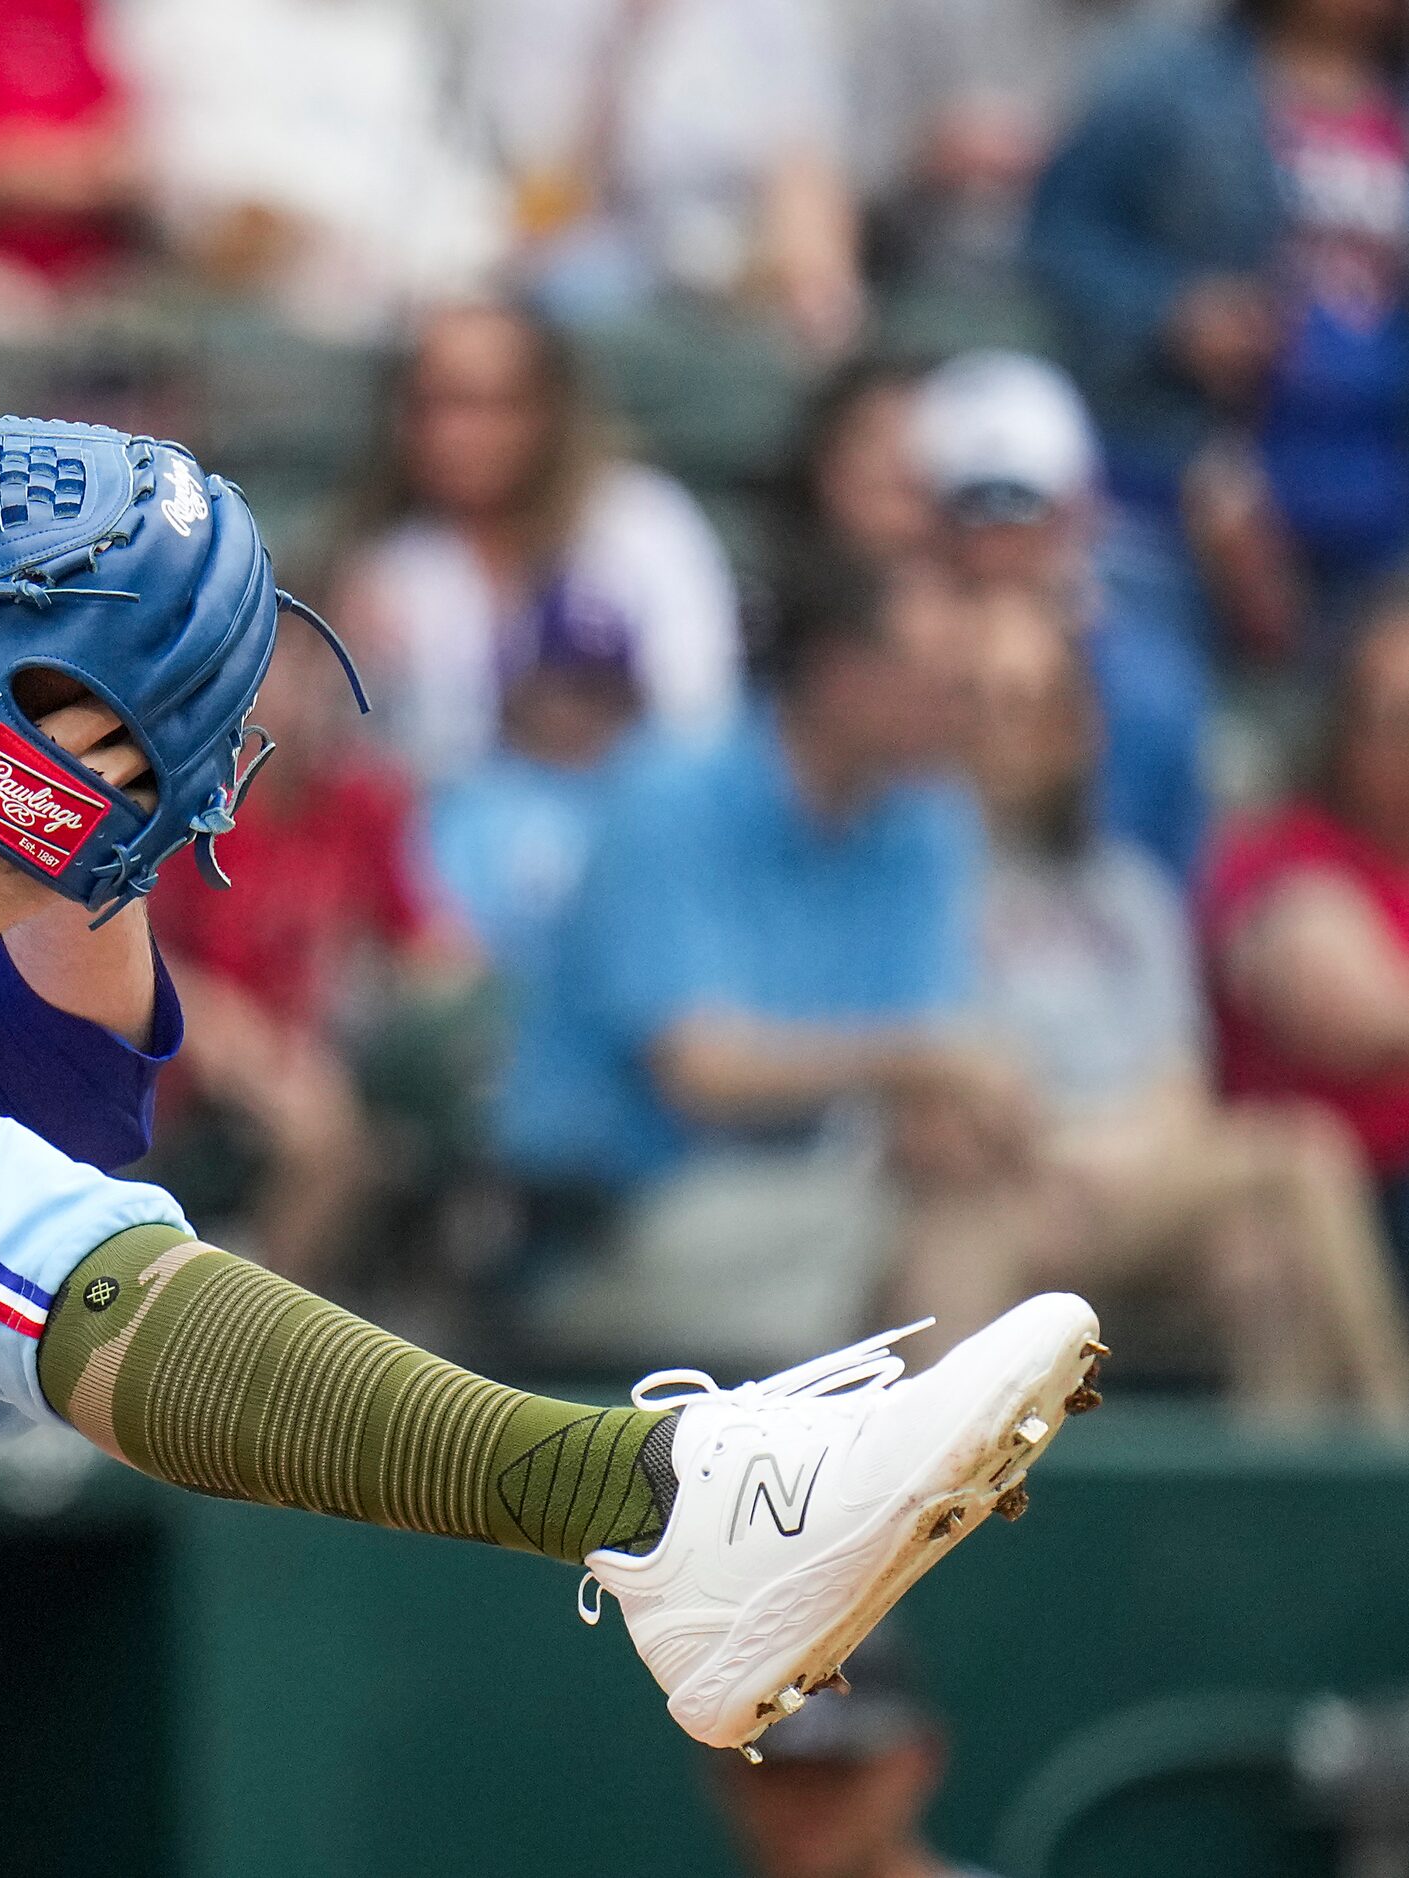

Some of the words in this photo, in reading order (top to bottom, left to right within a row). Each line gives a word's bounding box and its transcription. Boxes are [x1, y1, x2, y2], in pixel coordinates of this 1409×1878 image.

[18, 836, 37, 856] Est.
[36, 849, 60, 867] 1887
[728, 1446, 830, 1547] N
